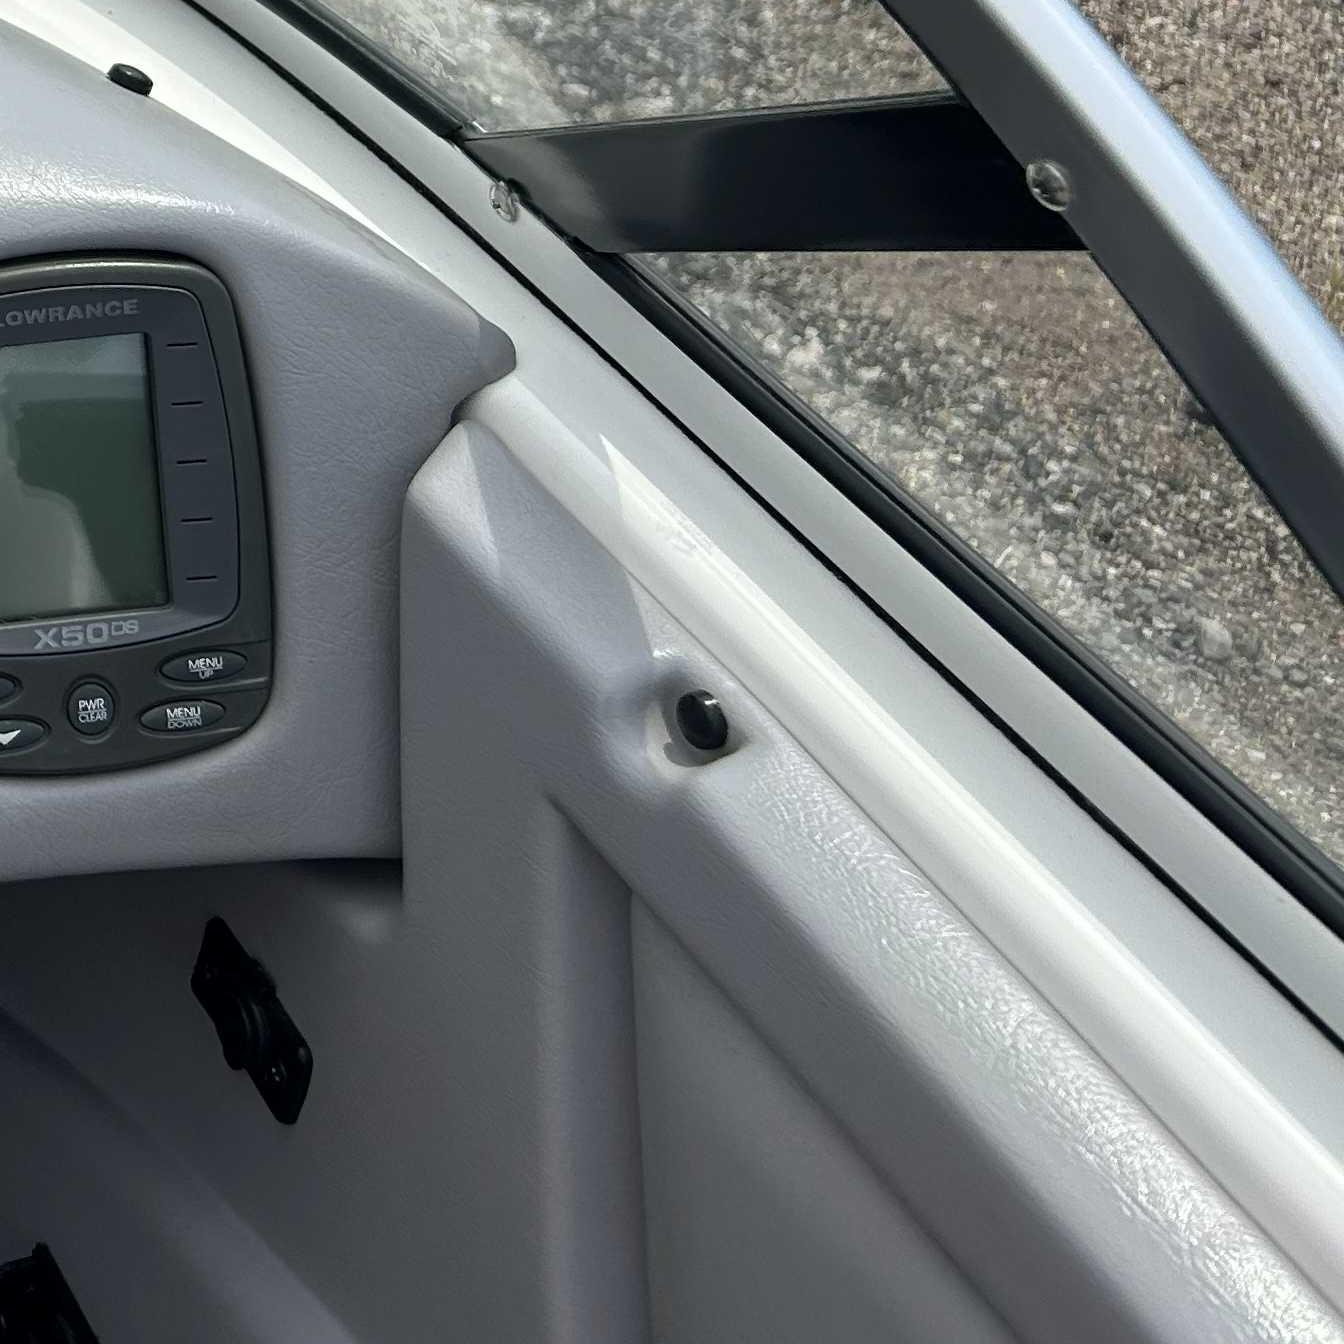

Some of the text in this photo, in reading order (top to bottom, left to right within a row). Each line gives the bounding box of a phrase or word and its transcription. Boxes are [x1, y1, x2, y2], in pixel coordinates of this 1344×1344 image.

[187, 656, 224, 670] MENU
[78, 698, 105, 711] PWR
[78, 710, 107, 723] CLEAR
[166, 706, 201, 720] MENU
[167, 717, 202, 729] DOWN
